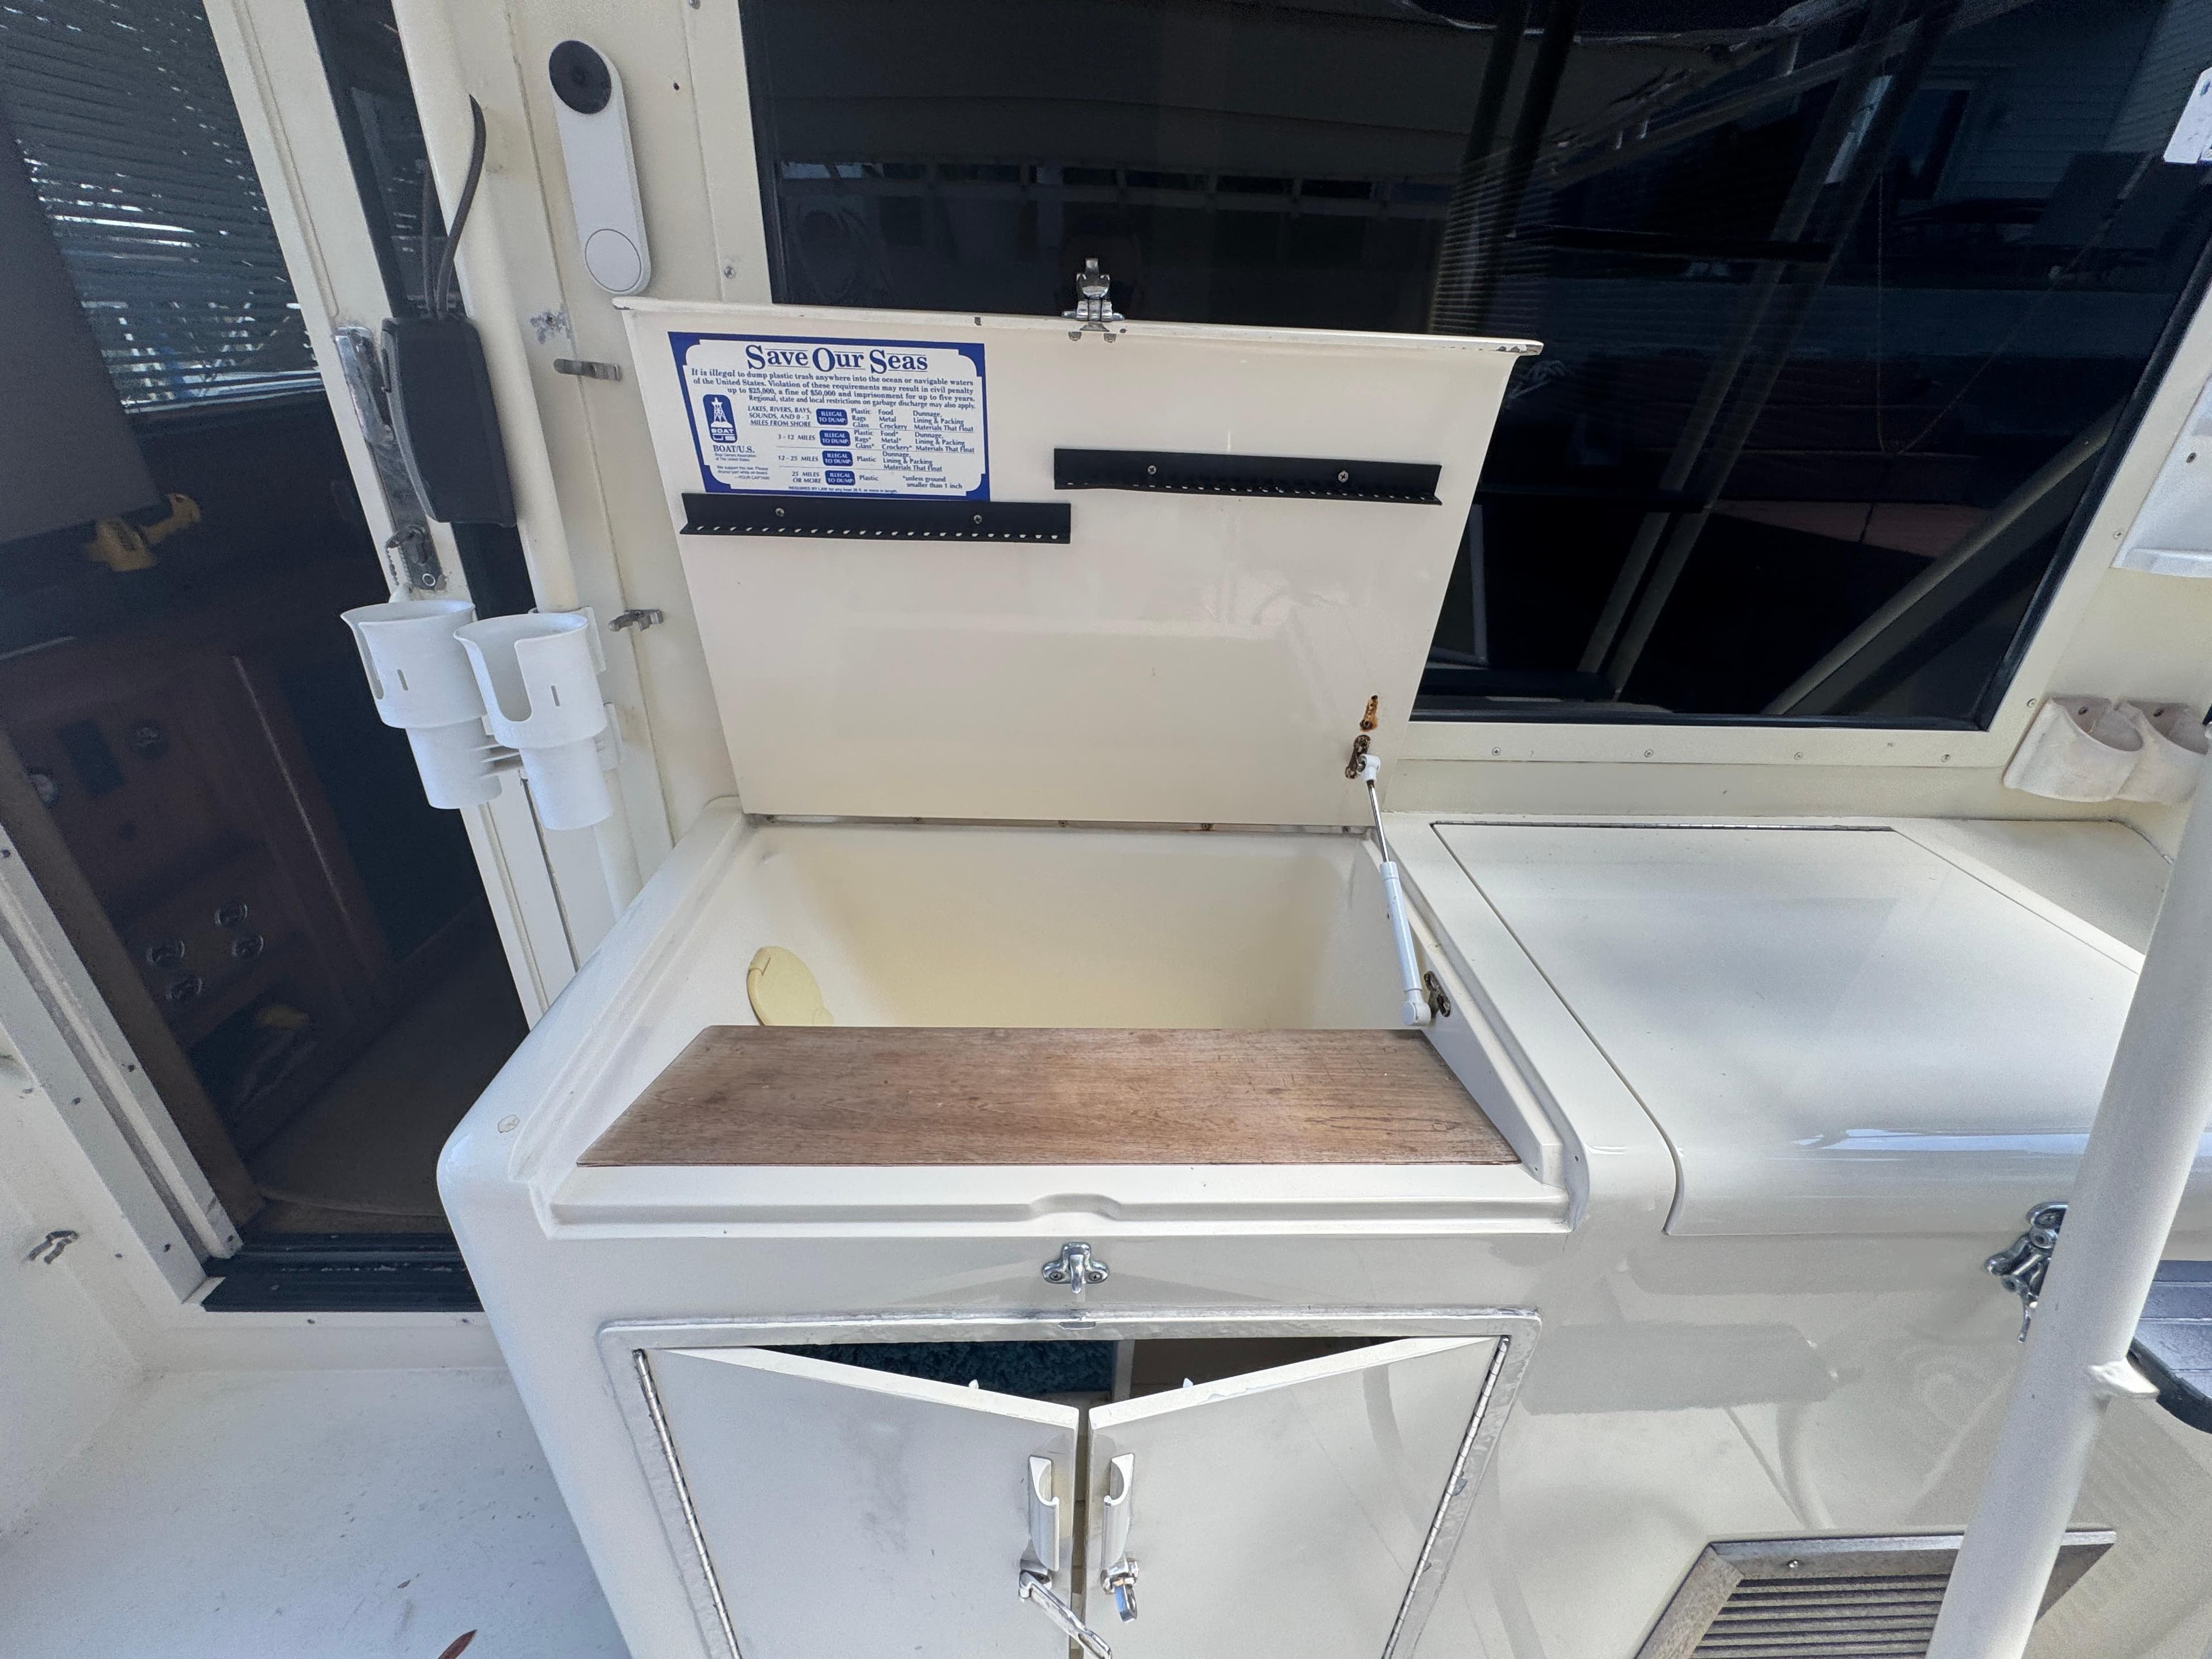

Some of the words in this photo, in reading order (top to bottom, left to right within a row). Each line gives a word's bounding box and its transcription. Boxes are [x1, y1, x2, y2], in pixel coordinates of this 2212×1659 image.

[745, 344, 808, 369] Save
[812, 347, 864, 372] Our
[869, 350, 927, 374] Seas
[700, 368, 707, 376] is
[709, 369, 735, 378] illegal
[746, 370, 767, 380] dump
[769, 372, 793, 380] plastic
[815, 374, 851, 382] anywhere
[914, 377, 948, 385] navigable
[748, 387, 777, 396] $25,000,
[810, 389, 836, 399] $50,000
[854, 391, 903, 399] imprisonment
[767, 380, 801, 388] Violation
[832, 382, 880, 391] requirements
[947, 387, 974, 396] penalty
[749, 395, 778, 403] Regional,
[872, 399, 896, 407] garbage
[898, 399, 927, 409] discharge
[957, 402, 976, 410] apply.
[912, 410, 942, 419] Dunnage,
[879, 422, 907, 431] Crockery
[913, 417, 932, 426] Lining
[940, 418, 964, 427] Packing
[915, 431, 944, 440] Dunnage,
[915, 438, 934, 446] Lining
[942, 439, 965, 448] Packing
[713, 445, 755, 453] BOAT/U.S.
[882, 450, 911, 460] Dunnage,
[882, 457, 903, 465] Lining
[909, 457, 933, 467] Packing
